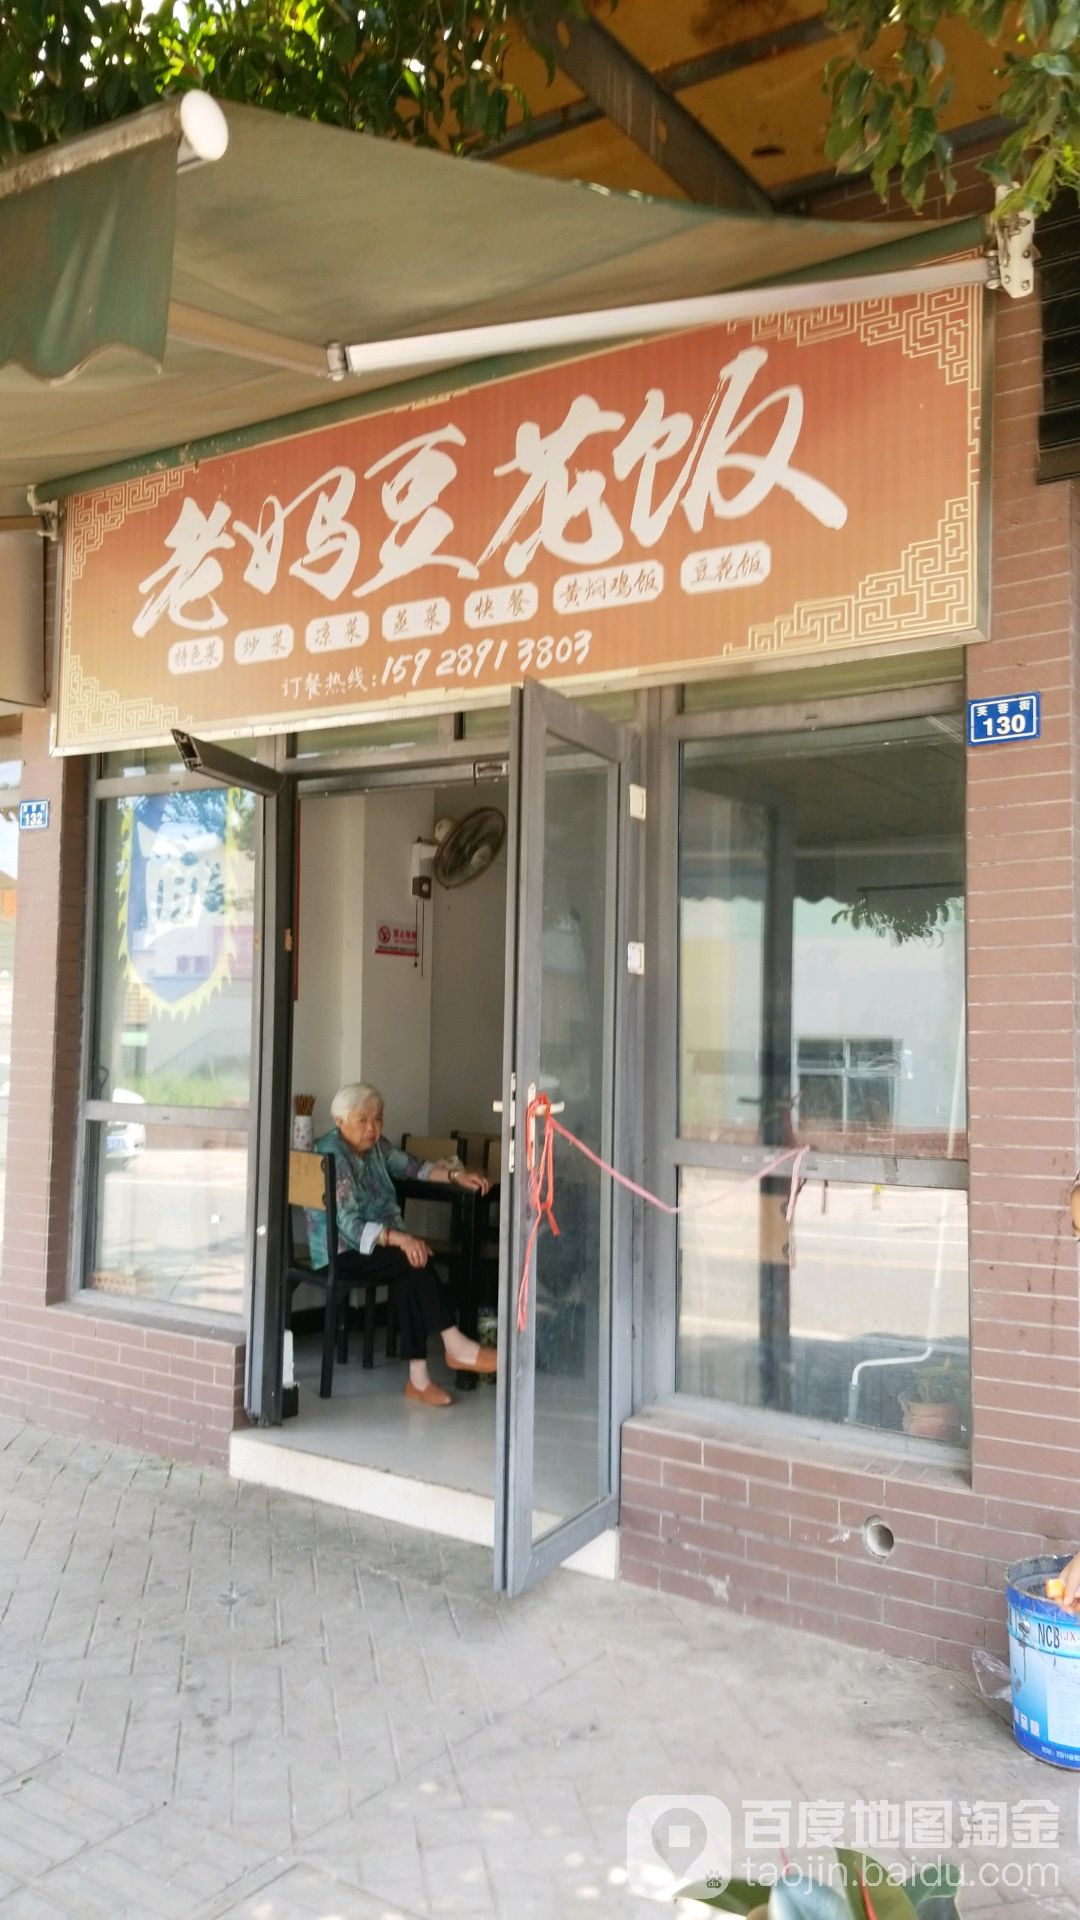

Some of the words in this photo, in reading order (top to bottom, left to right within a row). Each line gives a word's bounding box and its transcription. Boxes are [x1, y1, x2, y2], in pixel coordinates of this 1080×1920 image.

[132, 346, 848, 637] 老妈豆花饭
[174, 640, 219, 668] 特色菜
[241, 628, 286, 657] 炒菜
[474, 588, 531, 620] 快餐
[691, 549, 765, 585] 豆花饭
[983, 714, 1026, 736] 130
[25, 812, 43, 825] 132
[1038, 1622, 1060, 1649] NCB
